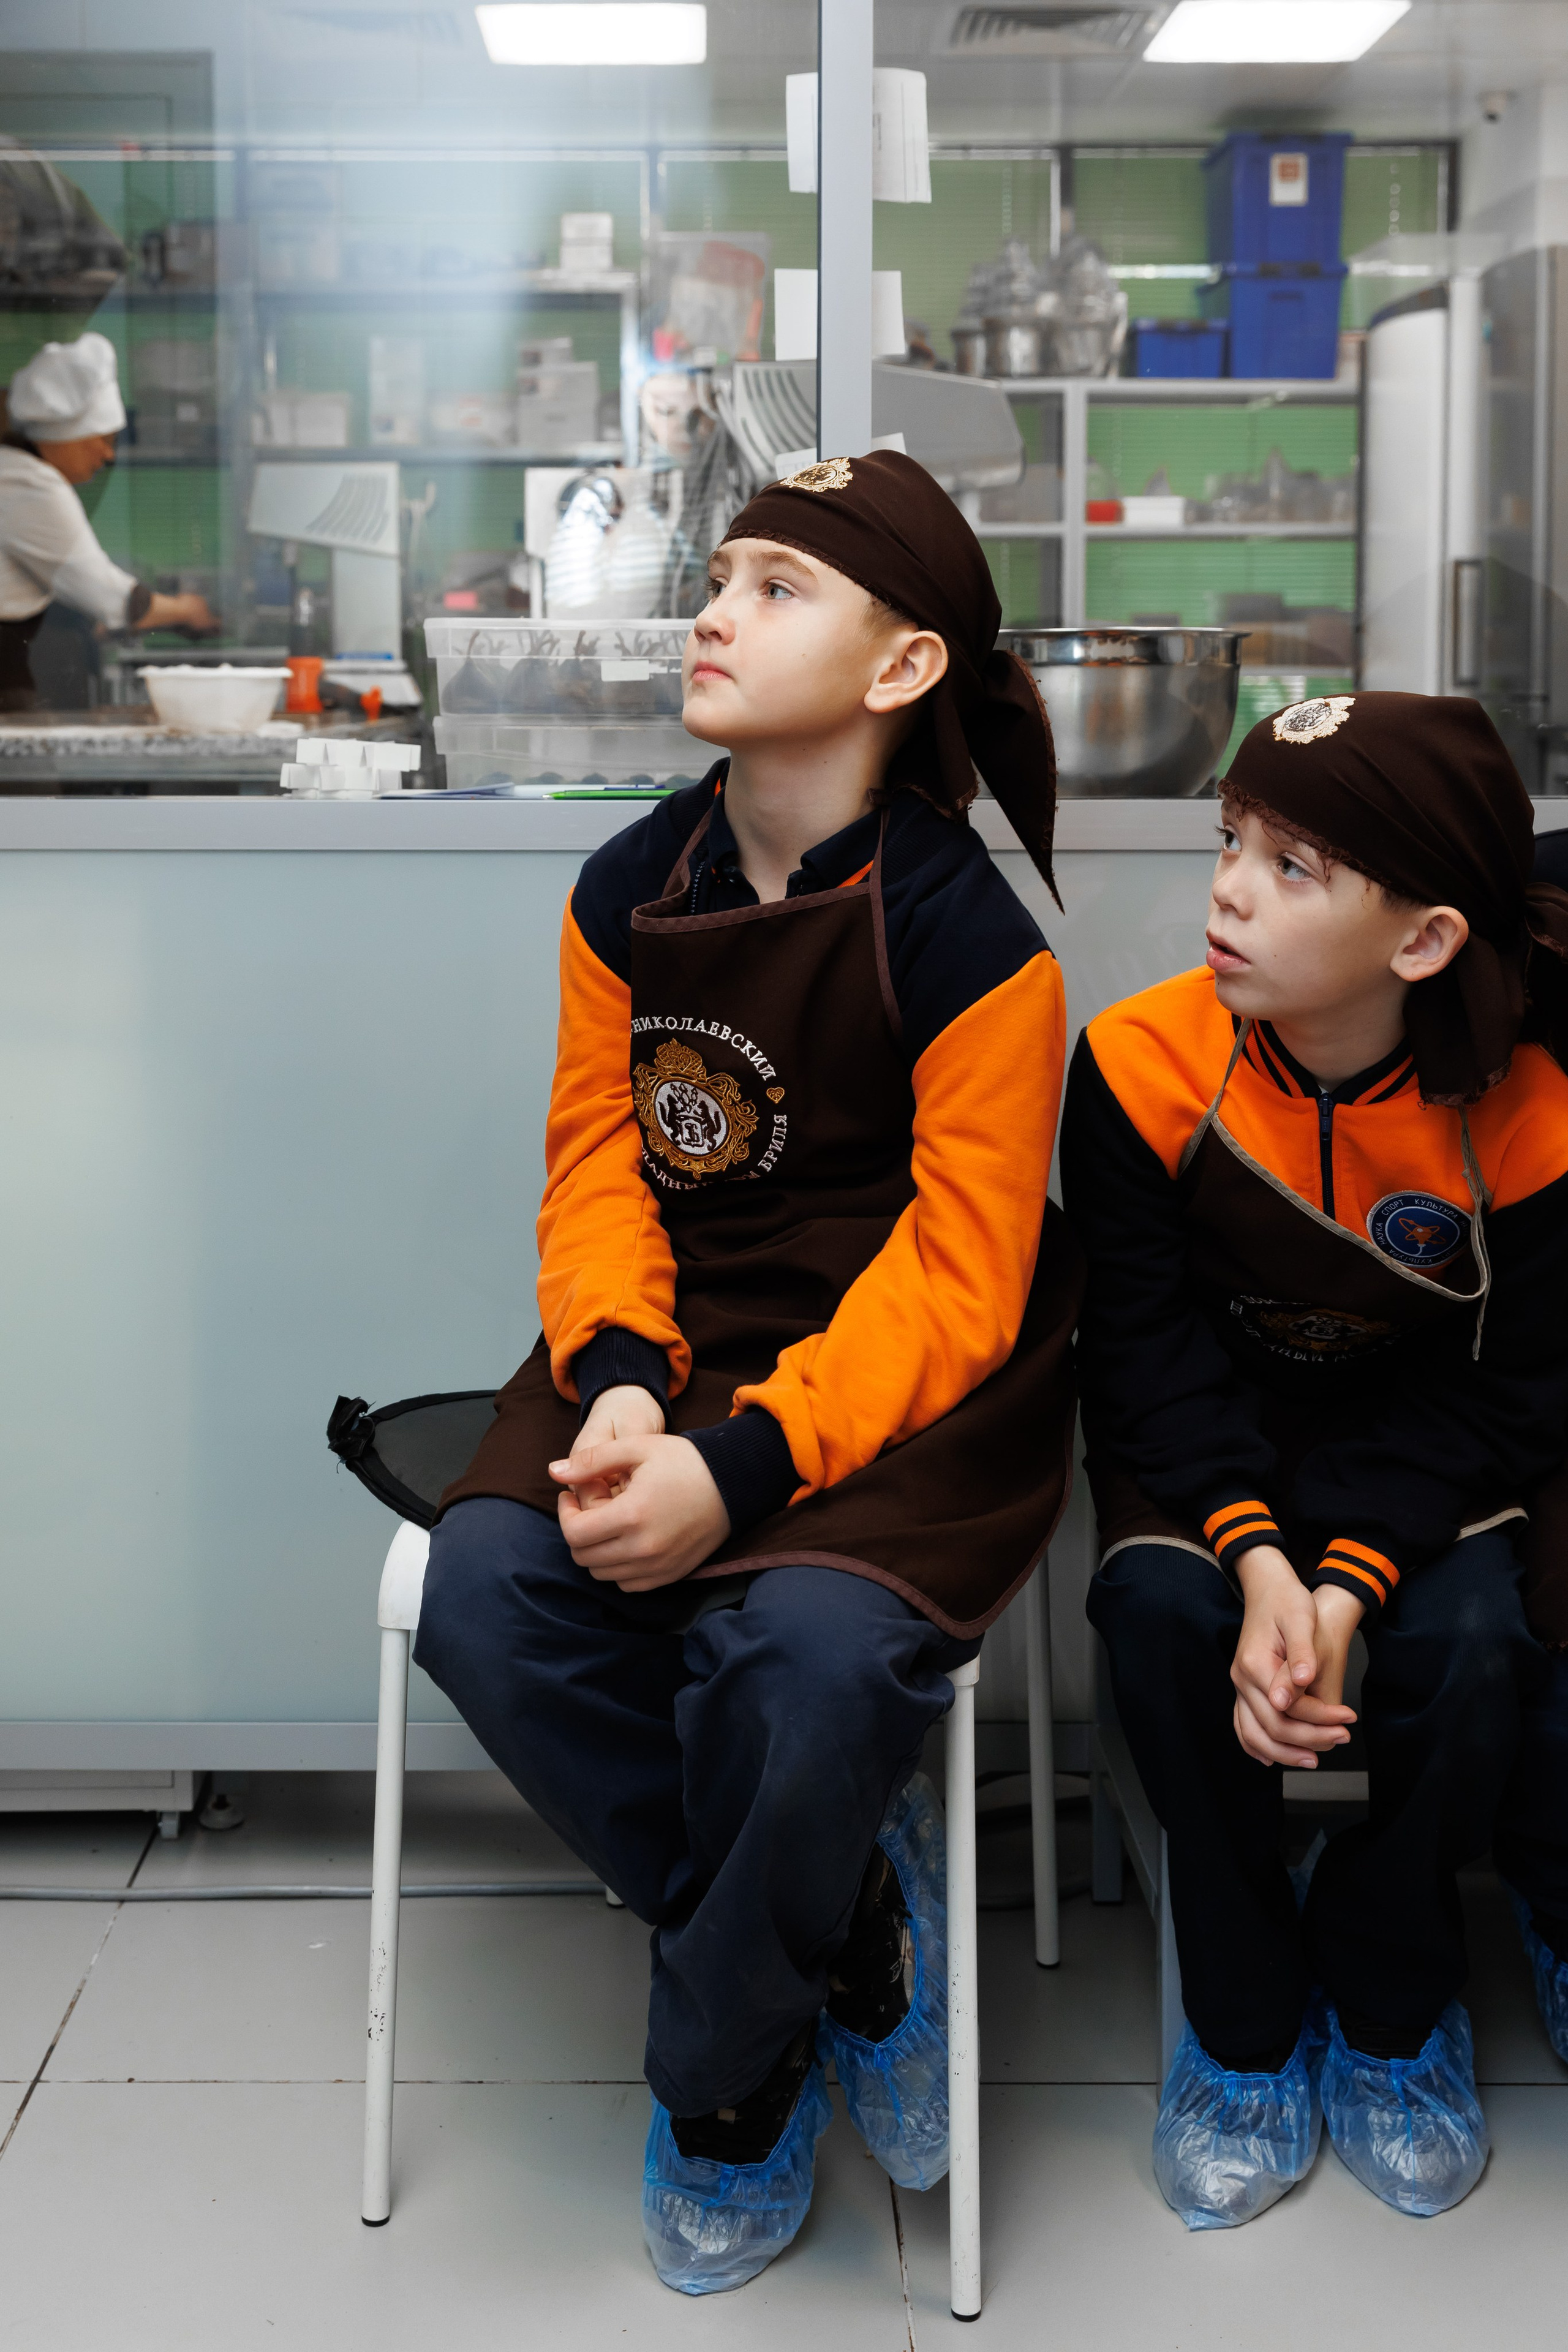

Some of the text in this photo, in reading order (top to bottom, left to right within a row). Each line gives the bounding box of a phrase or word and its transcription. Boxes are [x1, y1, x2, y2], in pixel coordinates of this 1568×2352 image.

[758, 1114, 787, 1172] БРИЛЯ
[1375, 1199, 1458, 1245] НАУКА СПОРТ КУЛЬТУРА
[1389, 1248, 1433, 1264] КУЛЬТУРА
